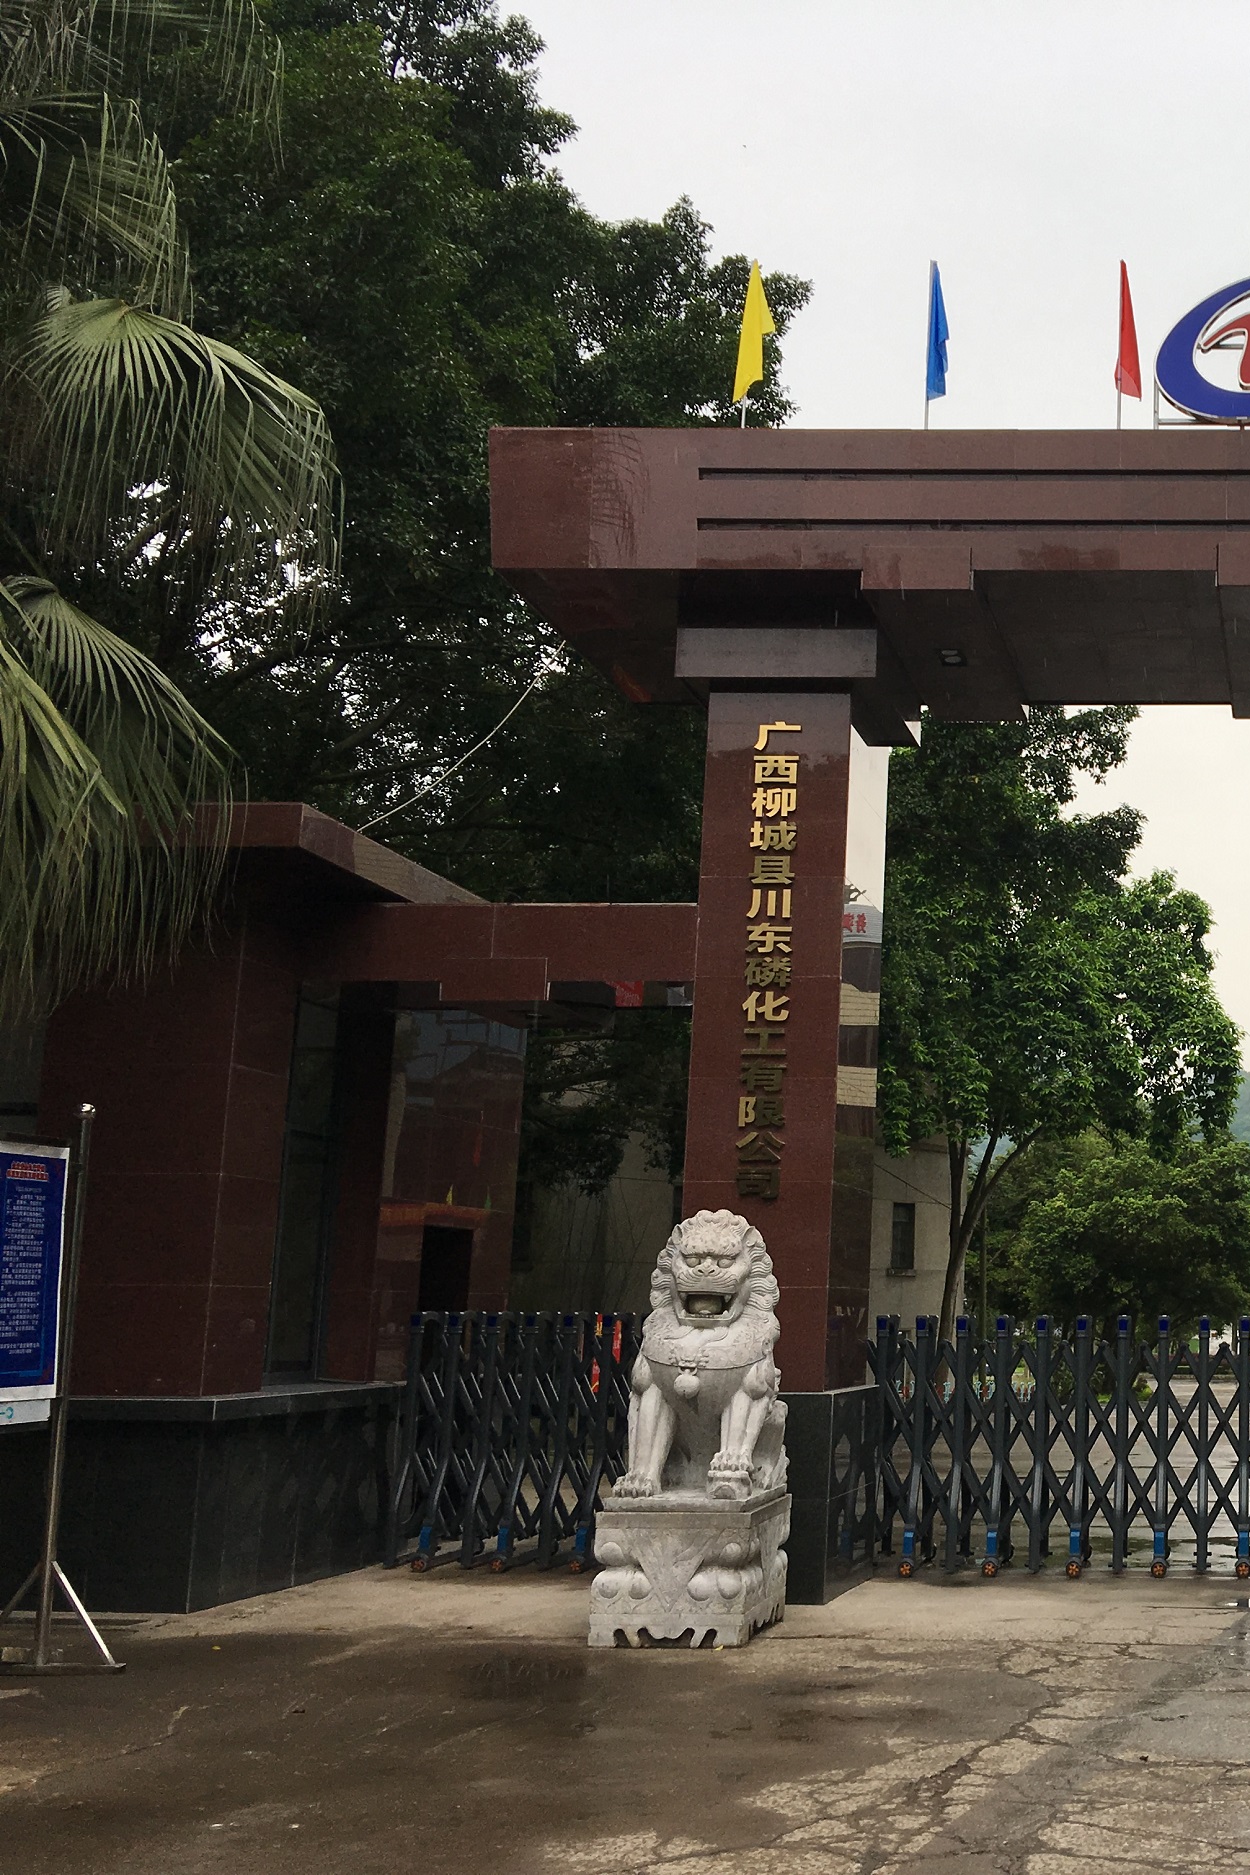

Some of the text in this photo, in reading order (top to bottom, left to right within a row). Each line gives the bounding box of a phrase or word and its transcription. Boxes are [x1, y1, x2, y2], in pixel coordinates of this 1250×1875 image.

[736, 721, 802, 1200] 广西柳城县川东磷化工有限公司
